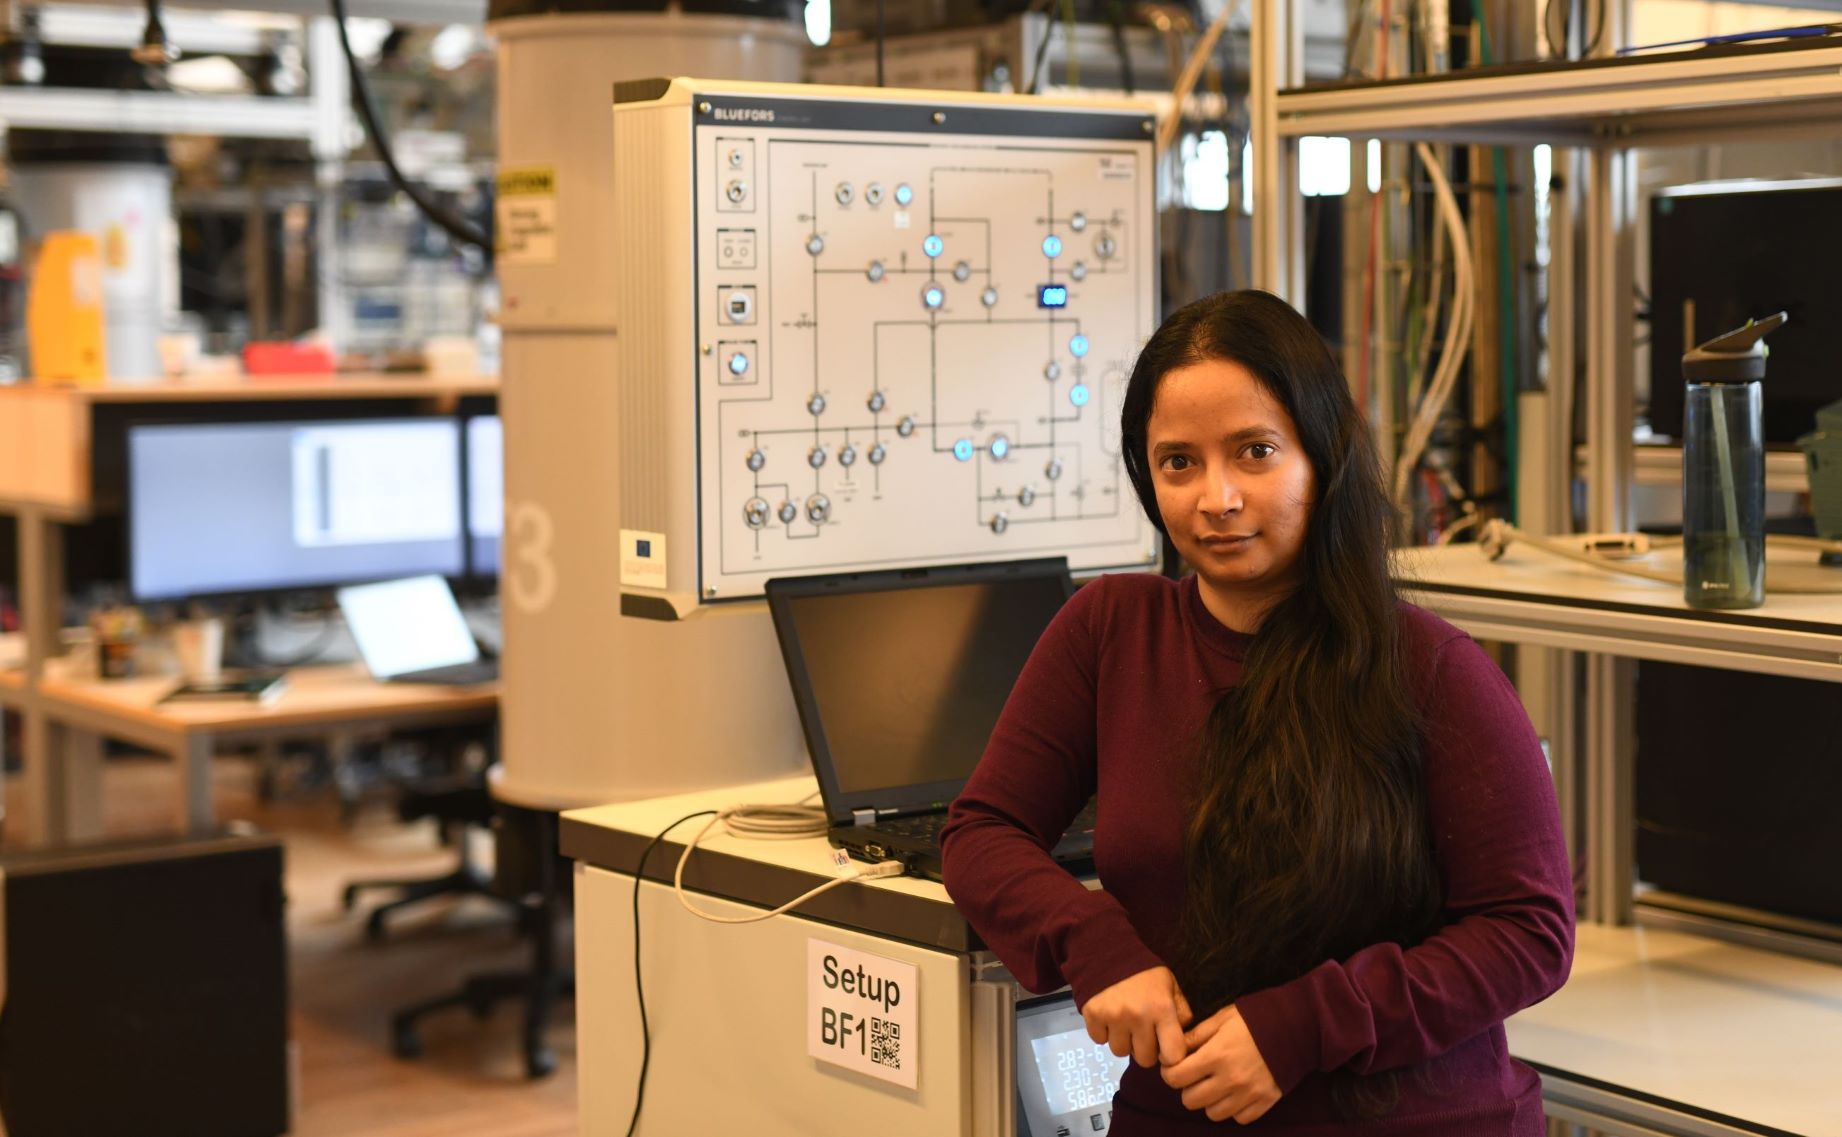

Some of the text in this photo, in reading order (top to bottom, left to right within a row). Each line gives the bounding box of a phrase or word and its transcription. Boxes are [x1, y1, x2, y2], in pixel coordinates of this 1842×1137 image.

[714, 107, 776, 122] BLUEFORS
[823, 955, 900, 1014] Setup
[822, 1006, 866, 1056] BF1
